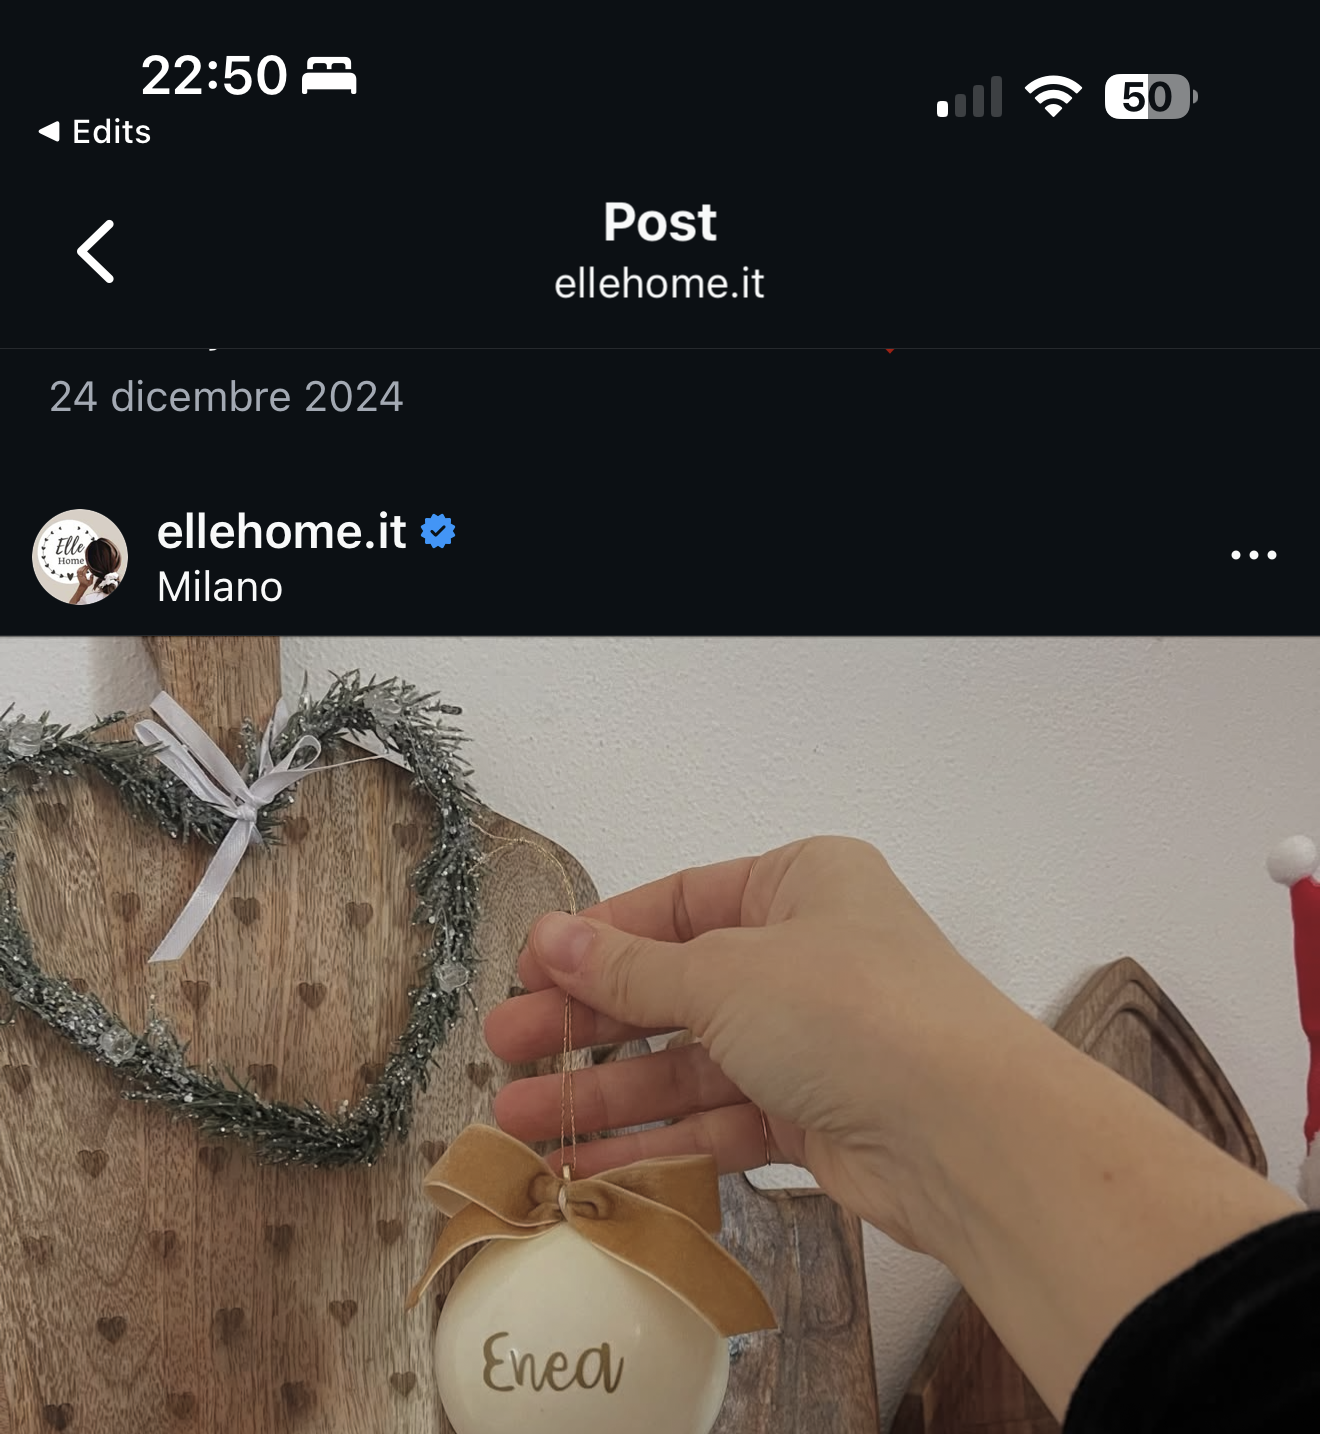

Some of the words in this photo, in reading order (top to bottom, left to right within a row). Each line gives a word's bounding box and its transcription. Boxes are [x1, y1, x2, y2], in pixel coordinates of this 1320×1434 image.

[141, 54, 288, 96] 22:50
[1122, 81, 1172, 112] 50
[73, 117, 151, 145] Edits
[604, 201, 718, 243] Post
[554, 265, 765, 299] ellehome.it
[50, 380, 98, 413] 24
[111, 379, 291, 413] dicembre
[305, 380, 404, 413] 2024
[55, 535, 85, 555] Elle
[157, 510, 407, 550] ellehome.it
[58, 557, 84, 565] Home
[158, 569, 283, 603] Milano
[482, 1330, 625, 1395] Enea
